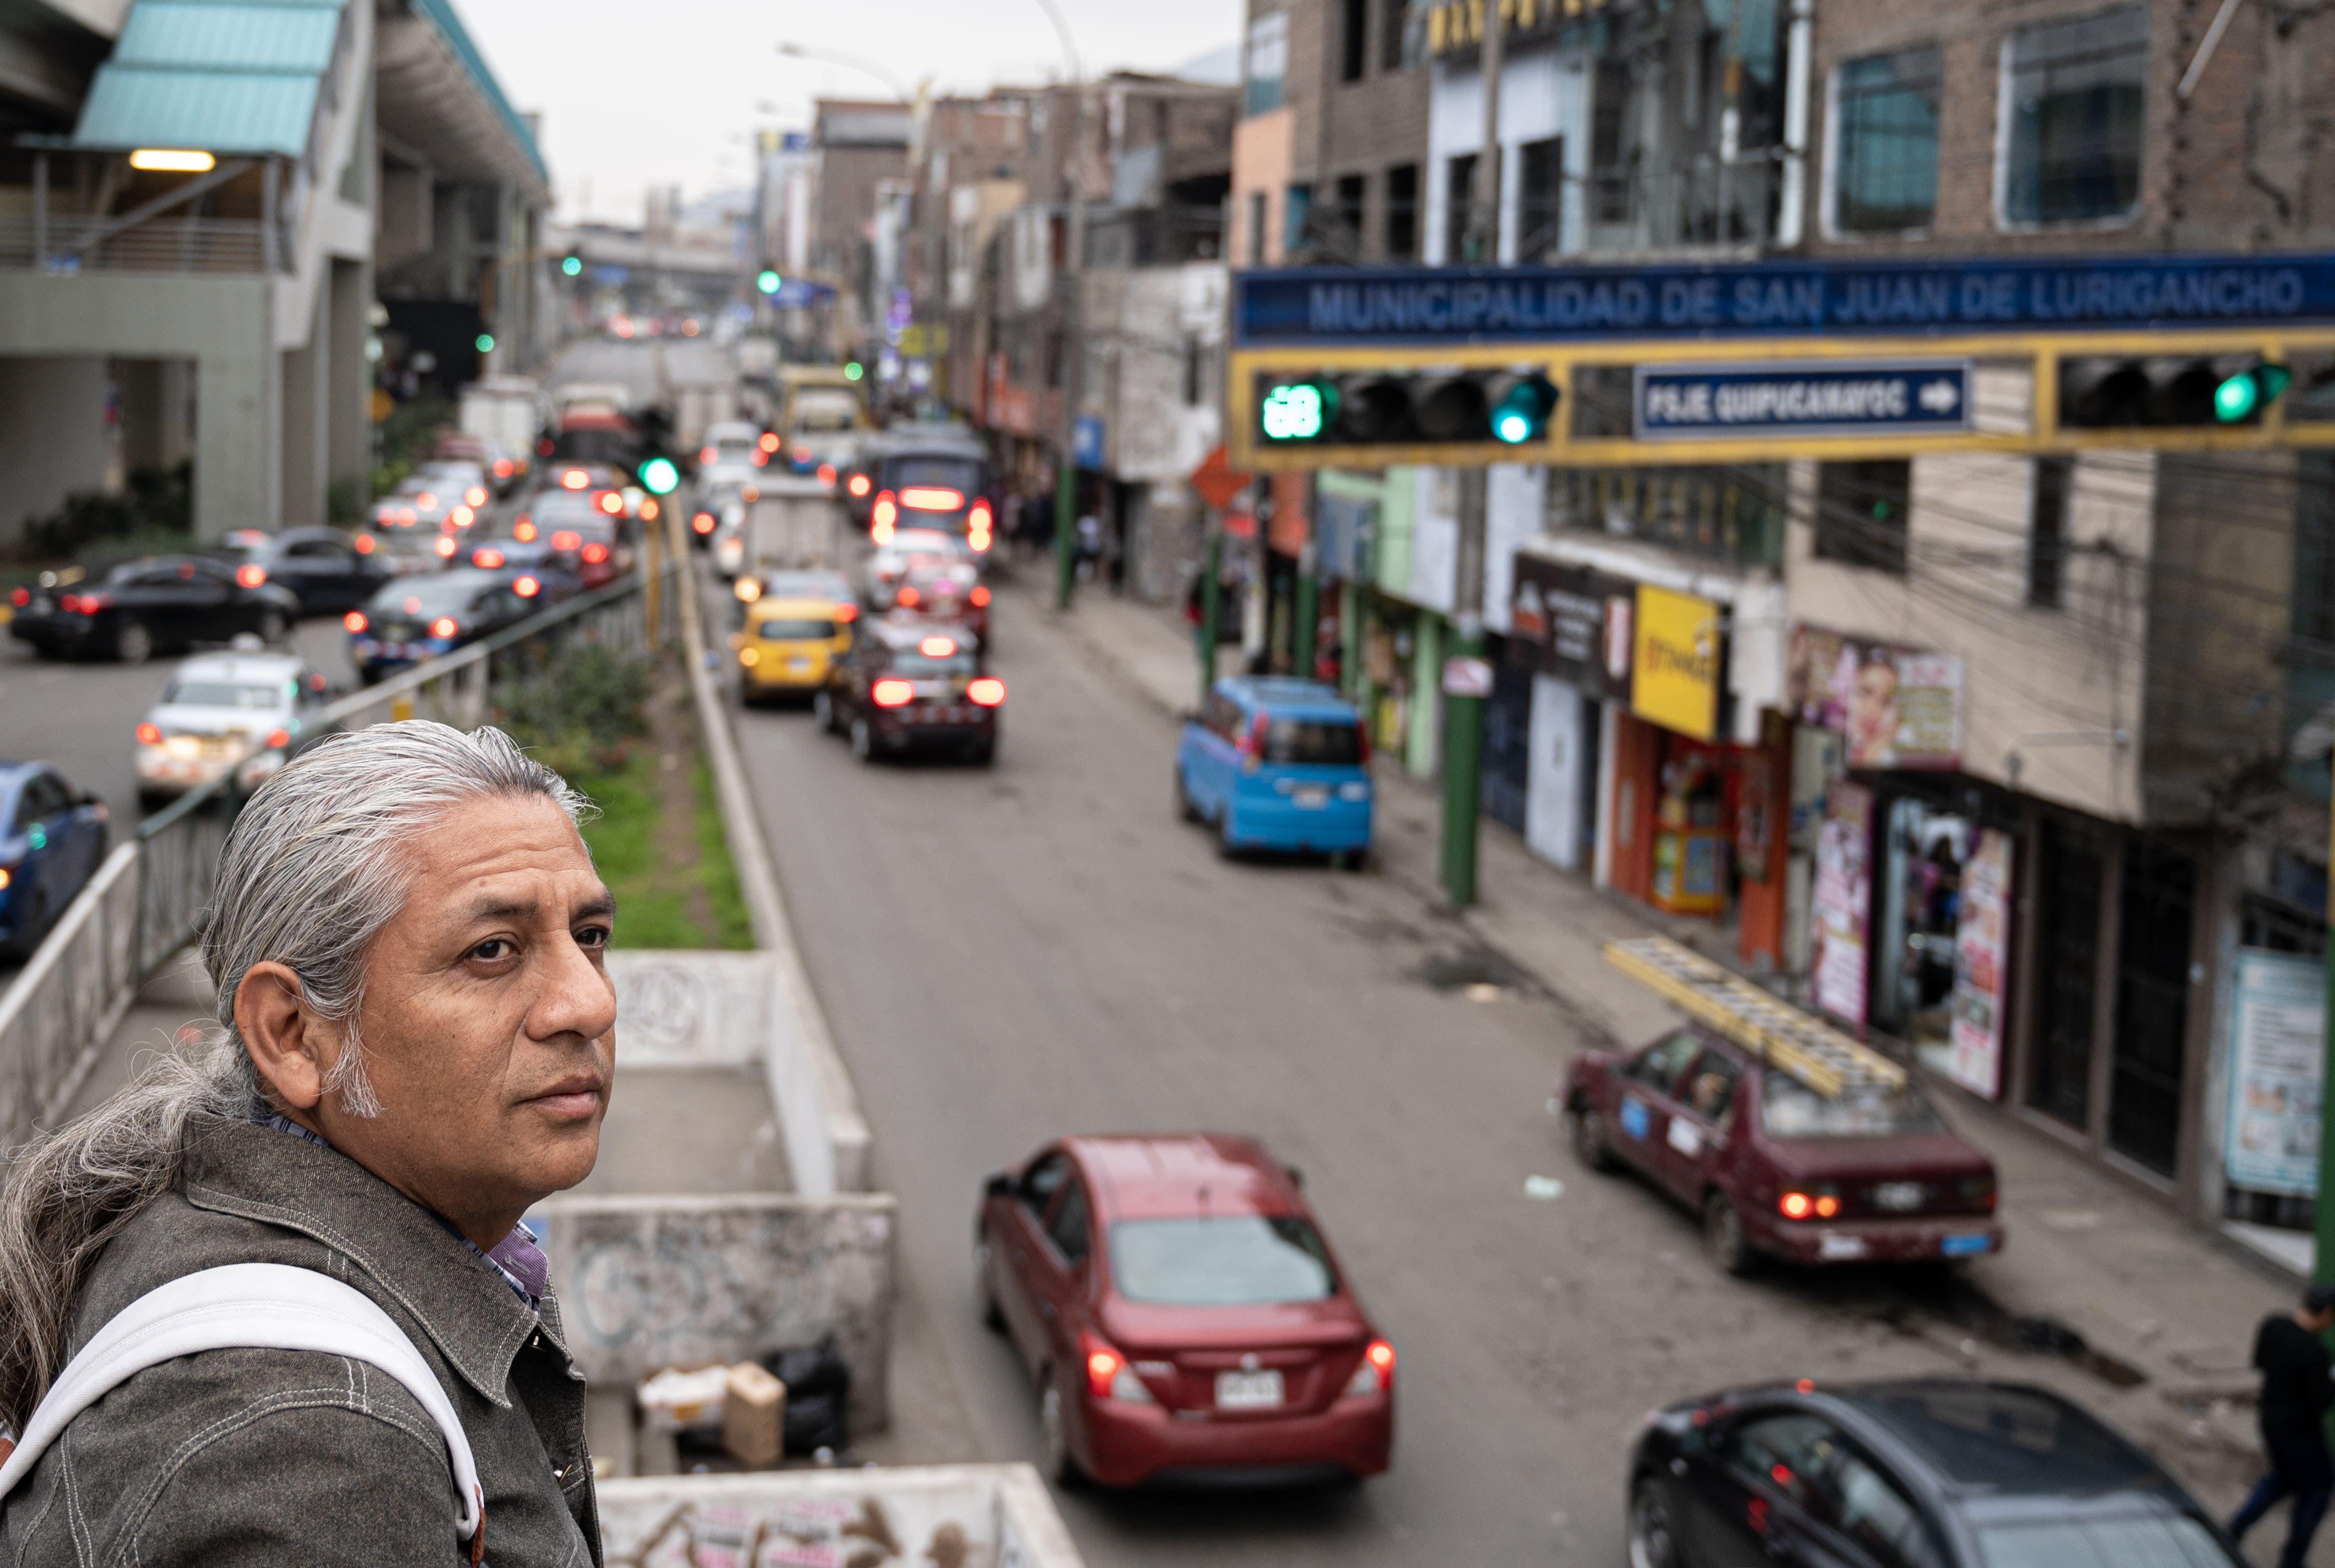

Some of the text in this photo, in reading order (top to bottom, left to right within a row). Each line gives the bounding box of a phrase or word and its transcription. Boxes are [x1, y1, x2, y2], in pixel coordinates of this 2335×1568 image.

[1308, 269, 2304, 330] MUNICIPALIDAD DE SAN JUAN DE LURIGANCHO
